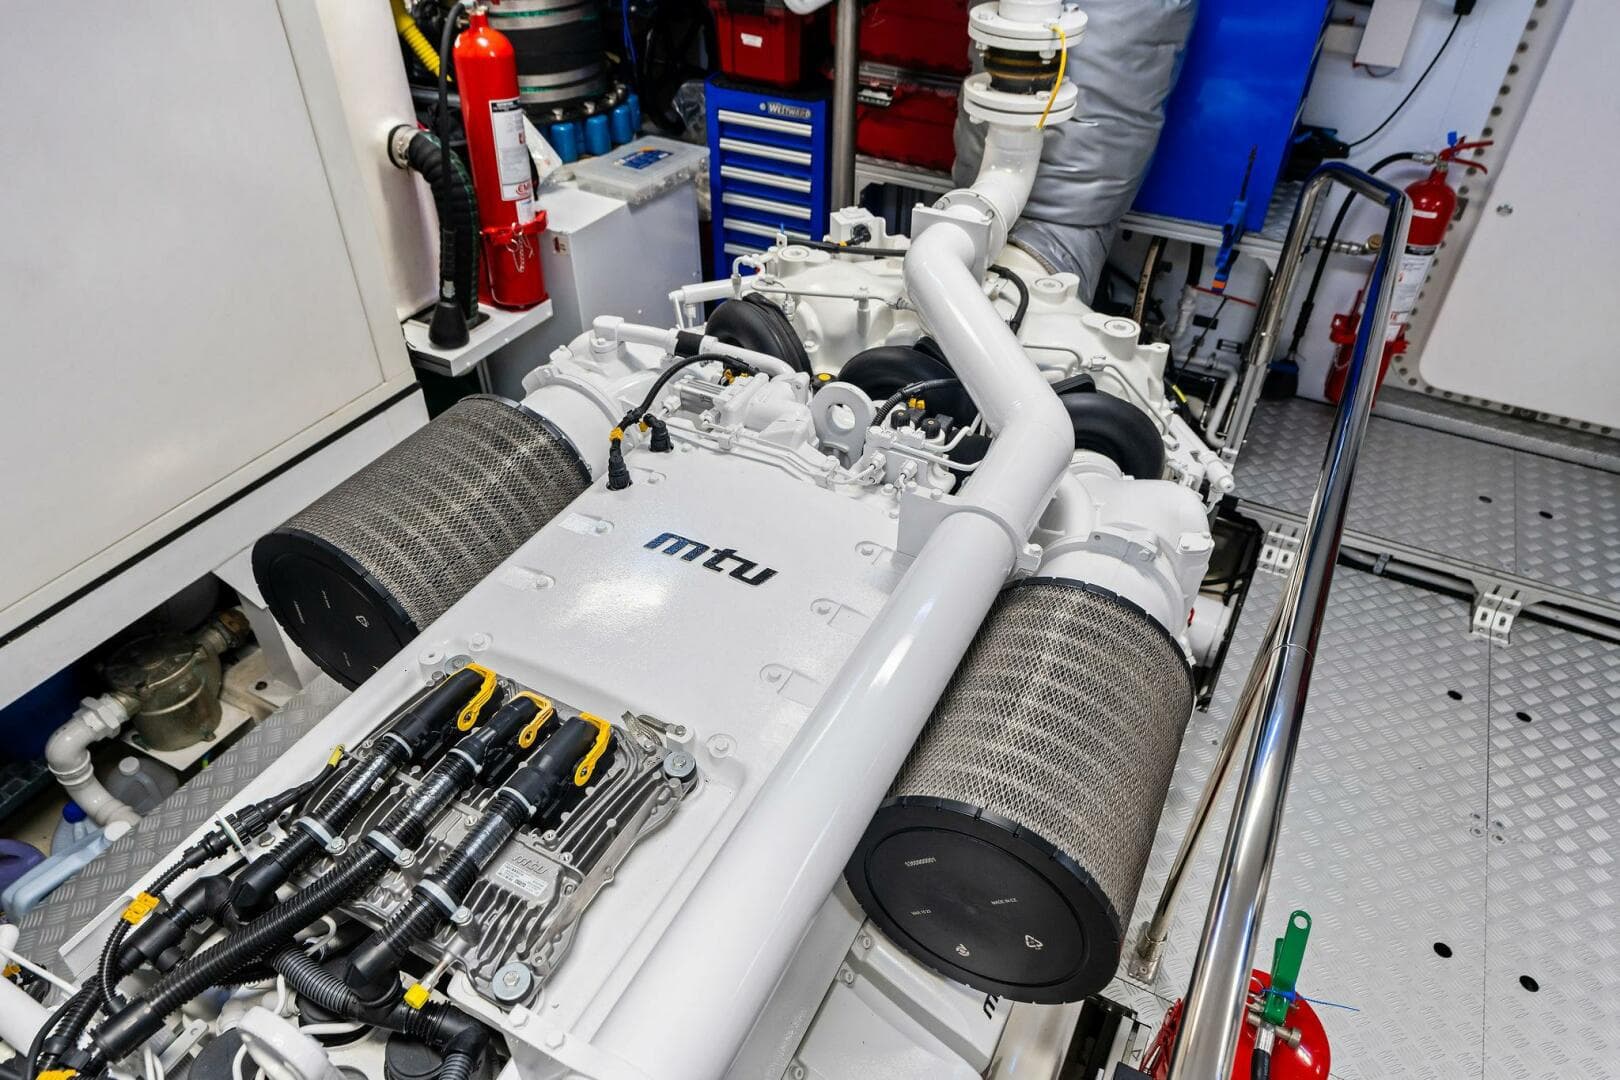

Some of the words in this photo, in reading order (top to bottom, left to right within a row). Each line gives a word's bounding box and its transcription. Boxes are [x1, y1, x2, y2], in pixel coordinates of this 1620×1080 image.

[768, 103, 811, 119] WESTWARD
[643, 532, 779, 585] mtu
[512, 855, 552, 875] mtu
